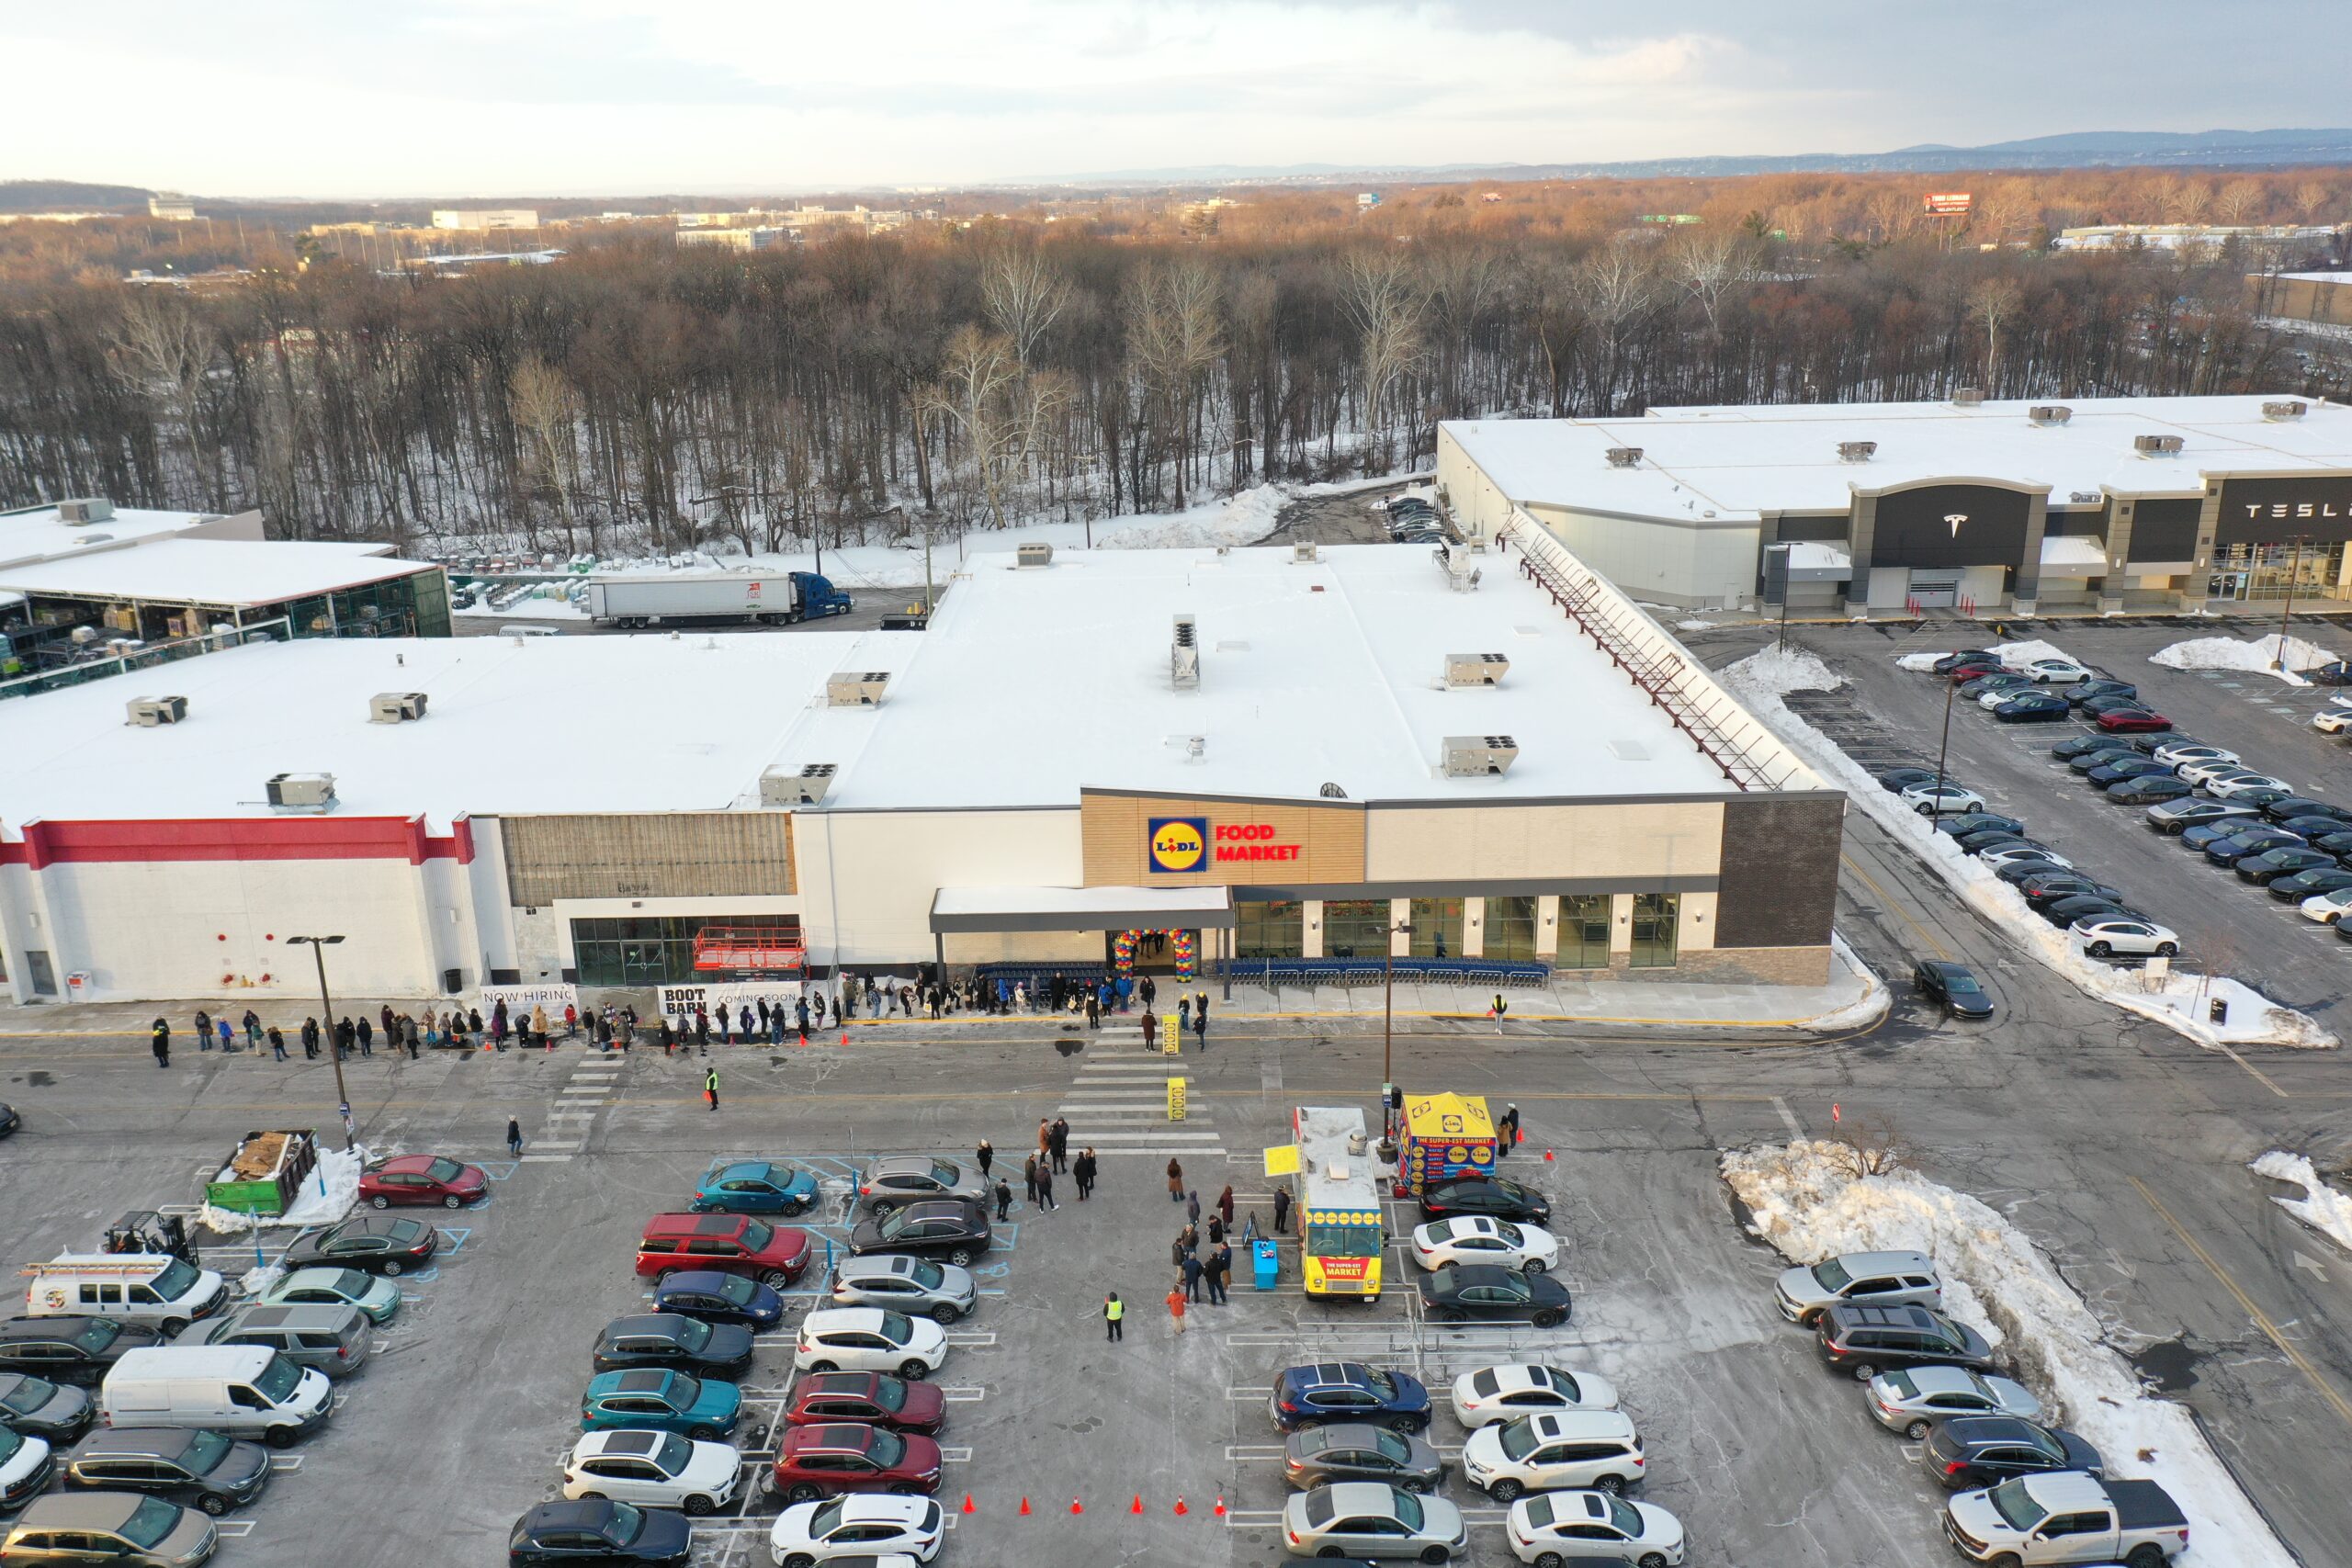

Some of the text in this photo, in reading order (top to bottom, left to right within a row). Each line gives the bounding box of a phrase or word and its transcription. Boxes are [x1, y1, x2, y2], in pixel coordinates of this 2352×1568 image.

[2245, 503, 2352, 518] TESL
[1216, 825, 1275, 840] FOOD
[1216, 844, 1301, 861] MARKET
[484, 990, 571, 1003] NOW HIRING
[664, 988, 706, 1001] BOOT
[718, 993, 796, 1004] COMING SOON
[666, 1001, 707, 1014] BARN
[1327, 1268, 1362, 1276] MARKET
